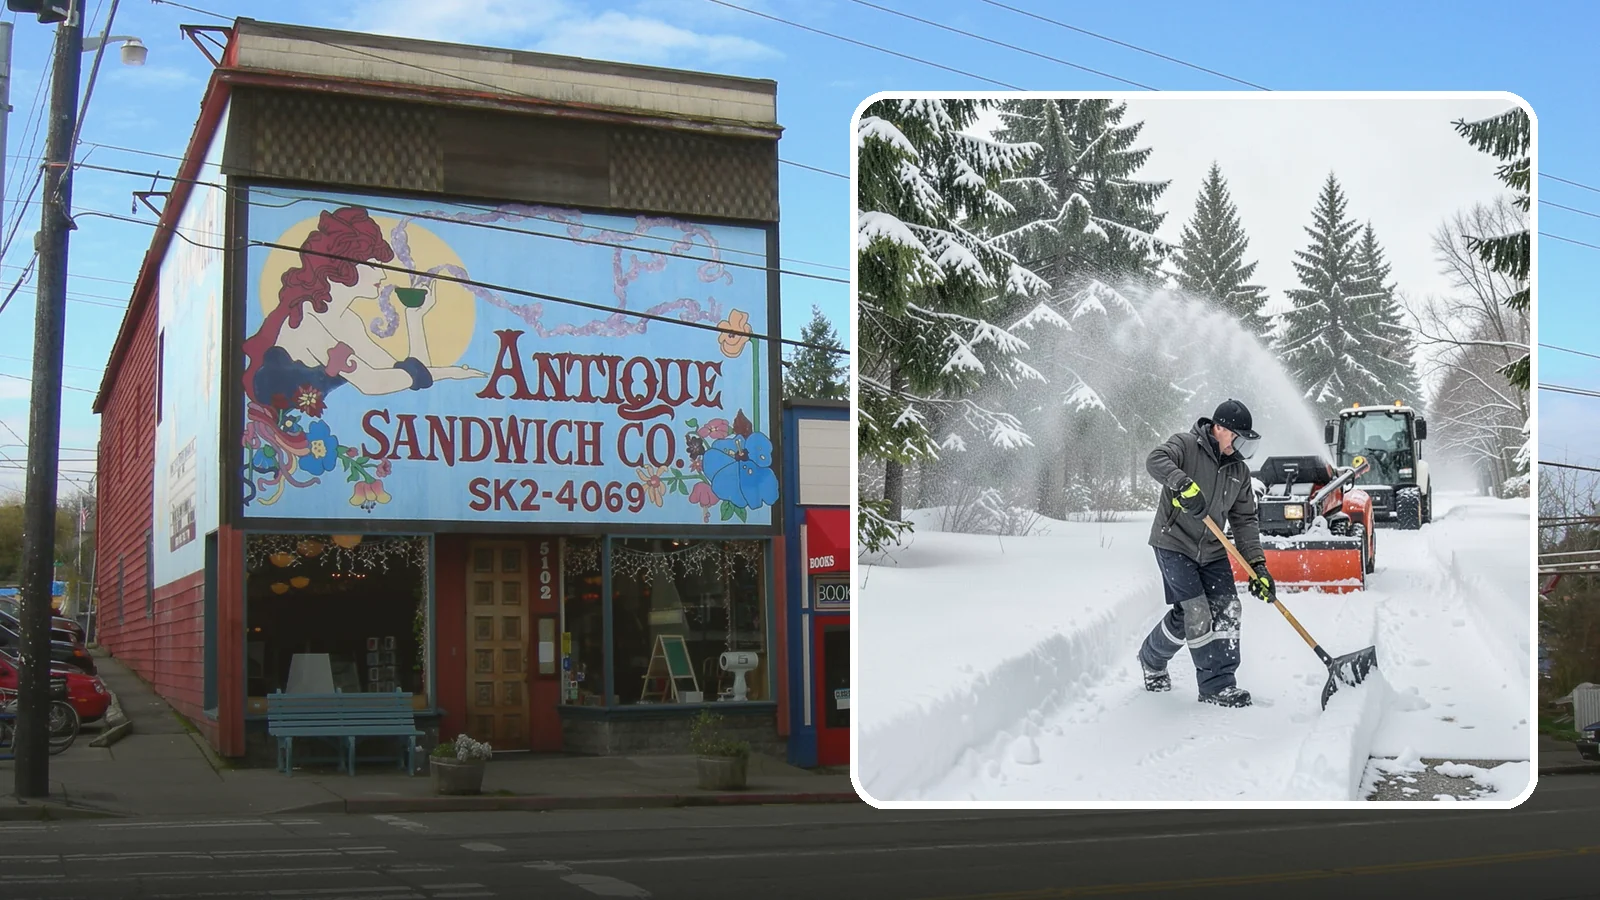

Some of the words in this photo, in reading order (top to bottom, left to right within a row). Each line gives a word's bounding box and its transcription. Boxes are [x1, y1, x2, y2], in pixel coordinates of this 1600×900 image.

[475, 329, 723, 421] ANTIQUE
[361, 408, 604, 467] SANDWICH
[617, 421, 685, 469] CO.
[468, 478, 646, 512] SK2-4069
[540, 541, 551, 599] 5102
[809, 555, 834, 569] BOOKS
